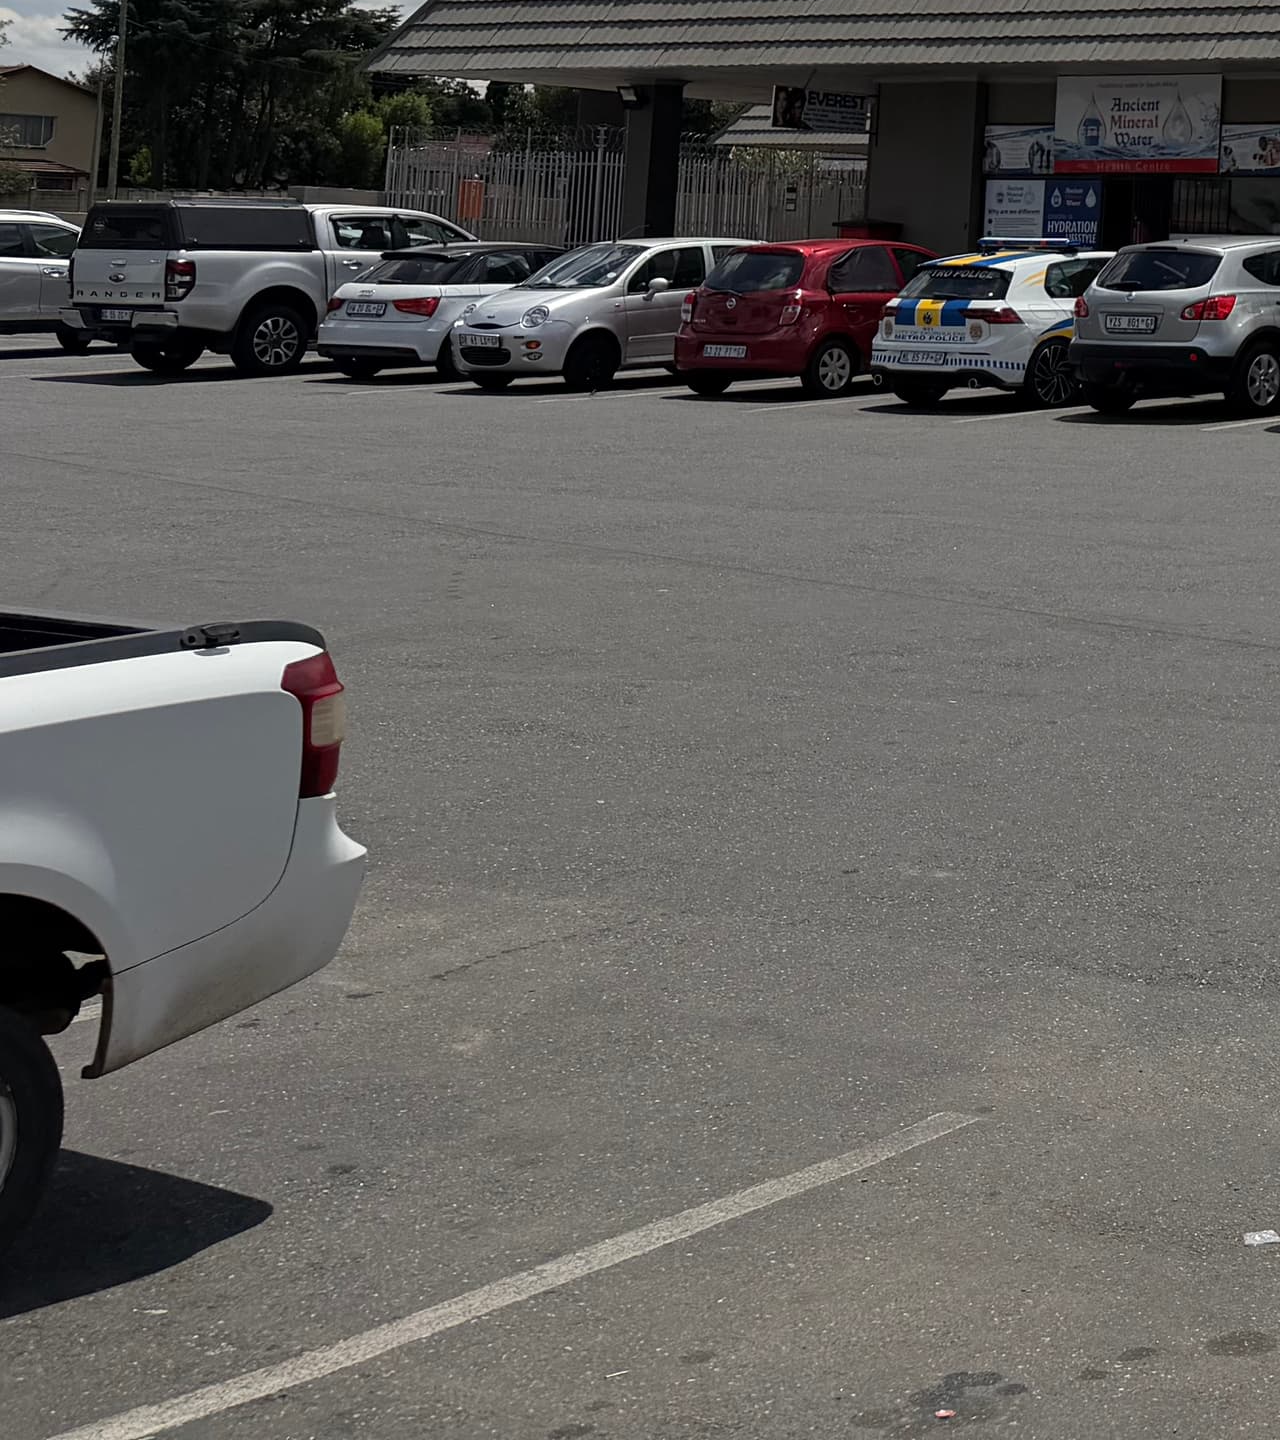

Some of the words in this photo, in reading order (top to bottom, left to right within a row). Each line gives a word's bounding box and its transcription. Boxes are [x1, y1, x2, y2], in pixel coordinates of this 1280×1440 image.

[807, 91, 866, 110] EVEREST
[1110, 97, 1160, 112] Ancient
[1109, 115, 1159, 133] Mineral
[1114, 132, 1154, 147] Water
[1047, 220, 1098, 233] HYDRATION
[953, 269, 993, 279] POLICE
[76, 289, 161, 299] RANGER
[894, 333, 926, 341] METRO
[929, 334, 966, 343] POLICE
